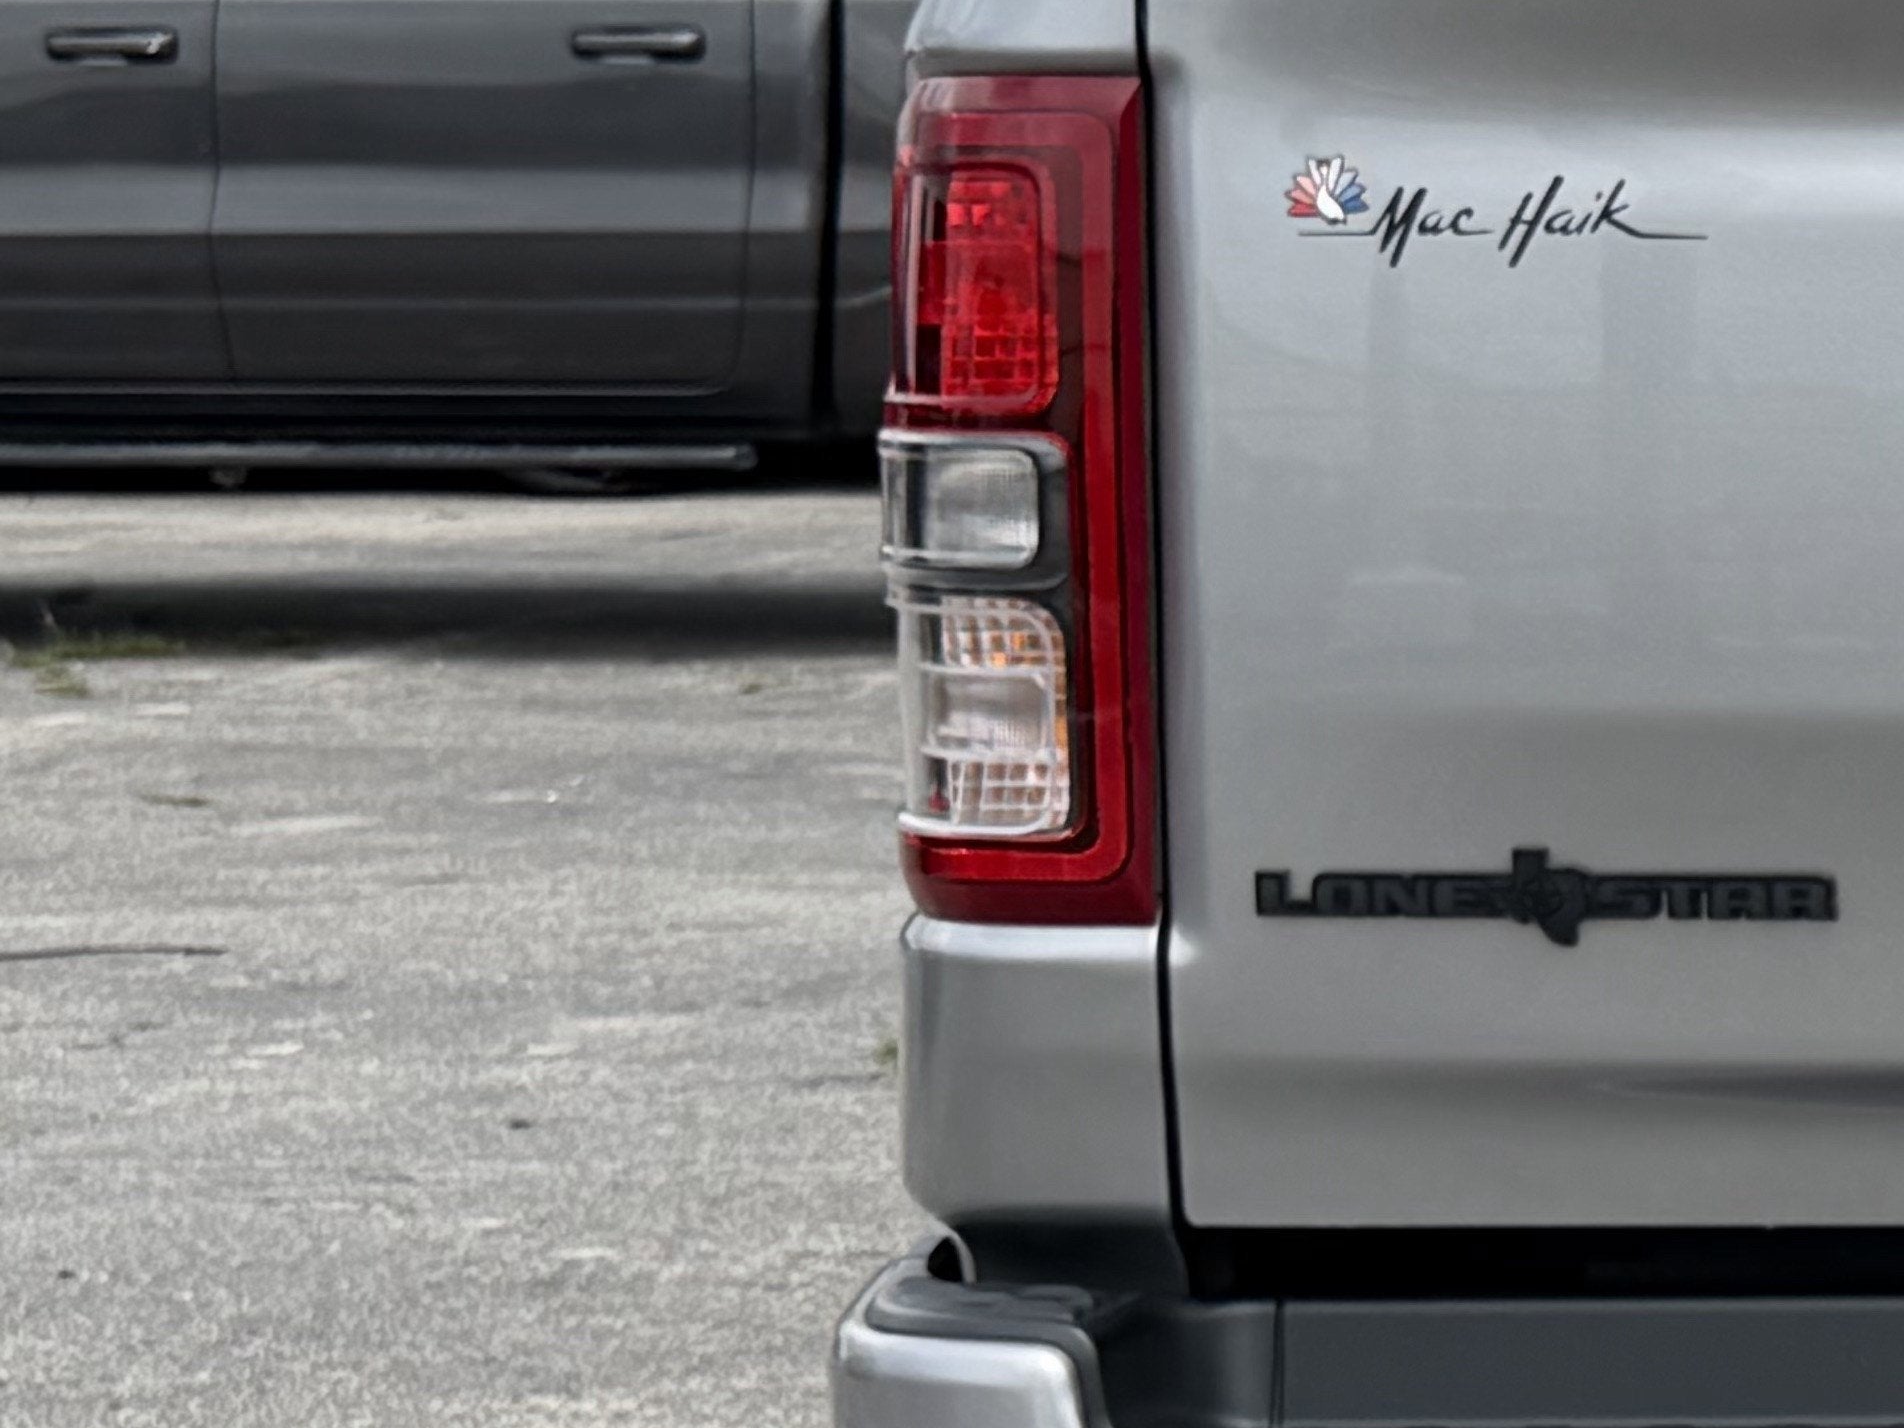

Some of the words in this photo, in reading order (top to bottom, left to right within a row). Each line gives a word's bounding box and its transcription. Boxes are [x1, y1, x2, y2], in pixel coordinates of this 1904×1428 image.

[1369, 186, 1493, 268] Mac
[1498, 175, 1708, 268] Haik
[1255, 869, 1510, 918] LONE
[1588, 872, 1838, 921] STAR
